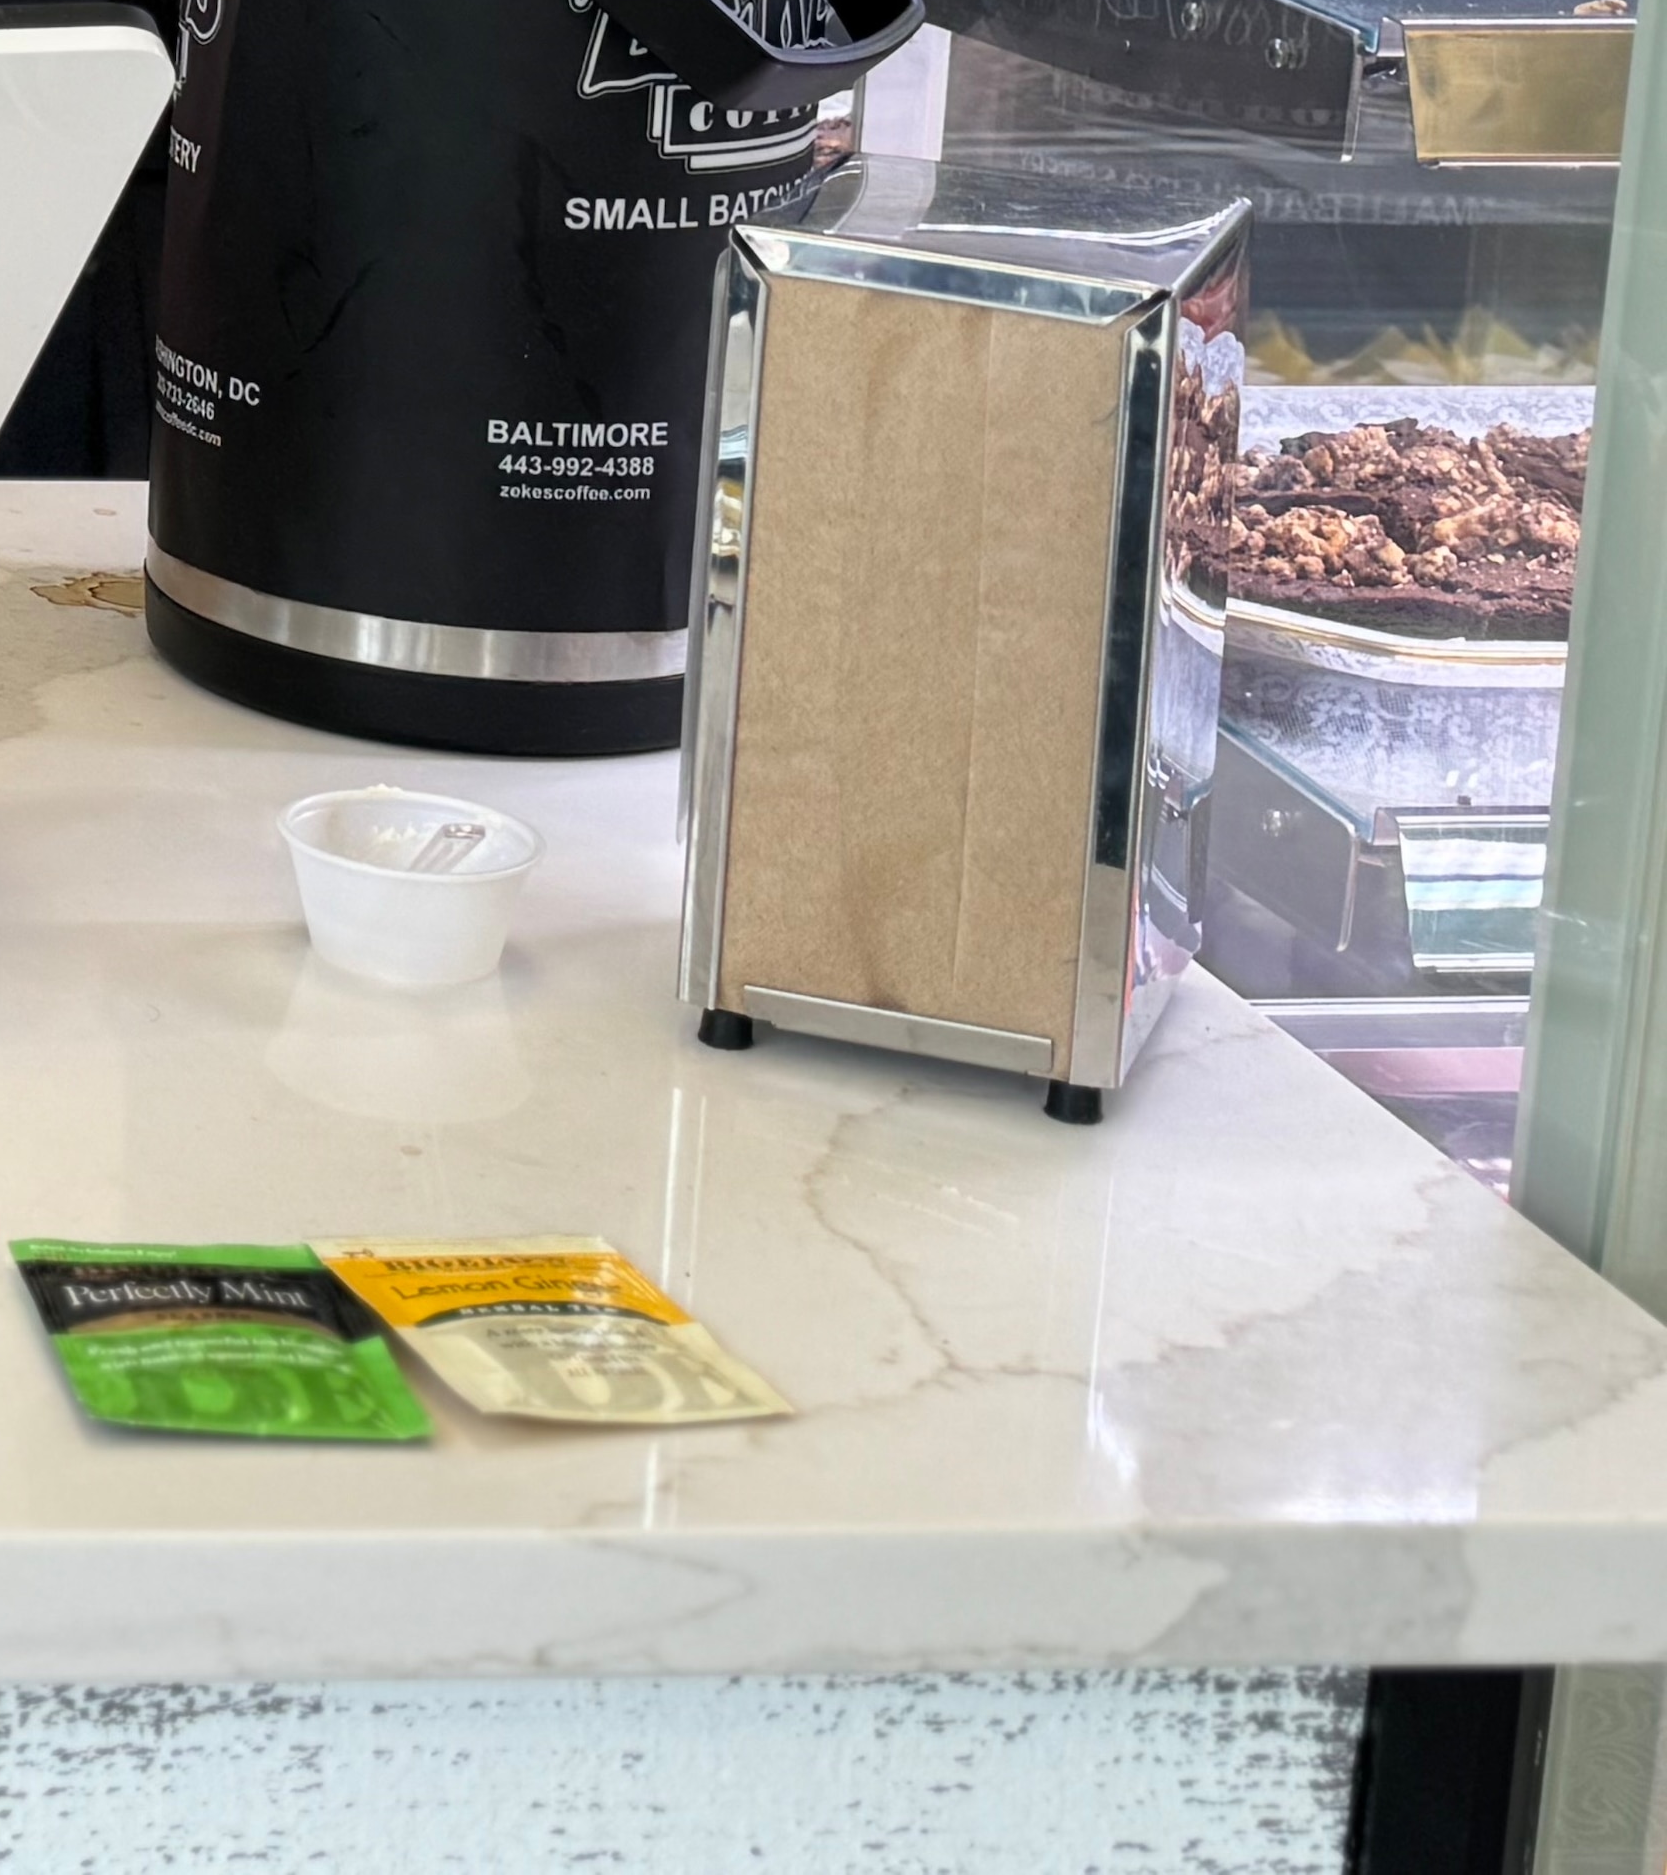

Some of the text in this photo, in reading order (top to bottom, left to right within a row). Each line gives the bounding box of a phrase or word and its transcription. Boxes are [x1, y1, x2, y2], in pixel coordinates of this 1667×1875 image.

[564, 196, 699, 230] SMALL
[229, 377, 260, 406] DC
[487, 419, 669, 448] BALTIMORE
[498, 454, 655, 476] 443-992-4388
[62, 1279, 312, 1308] Perfectly Mint
[390, 1277, 508, 1301] Lemon
